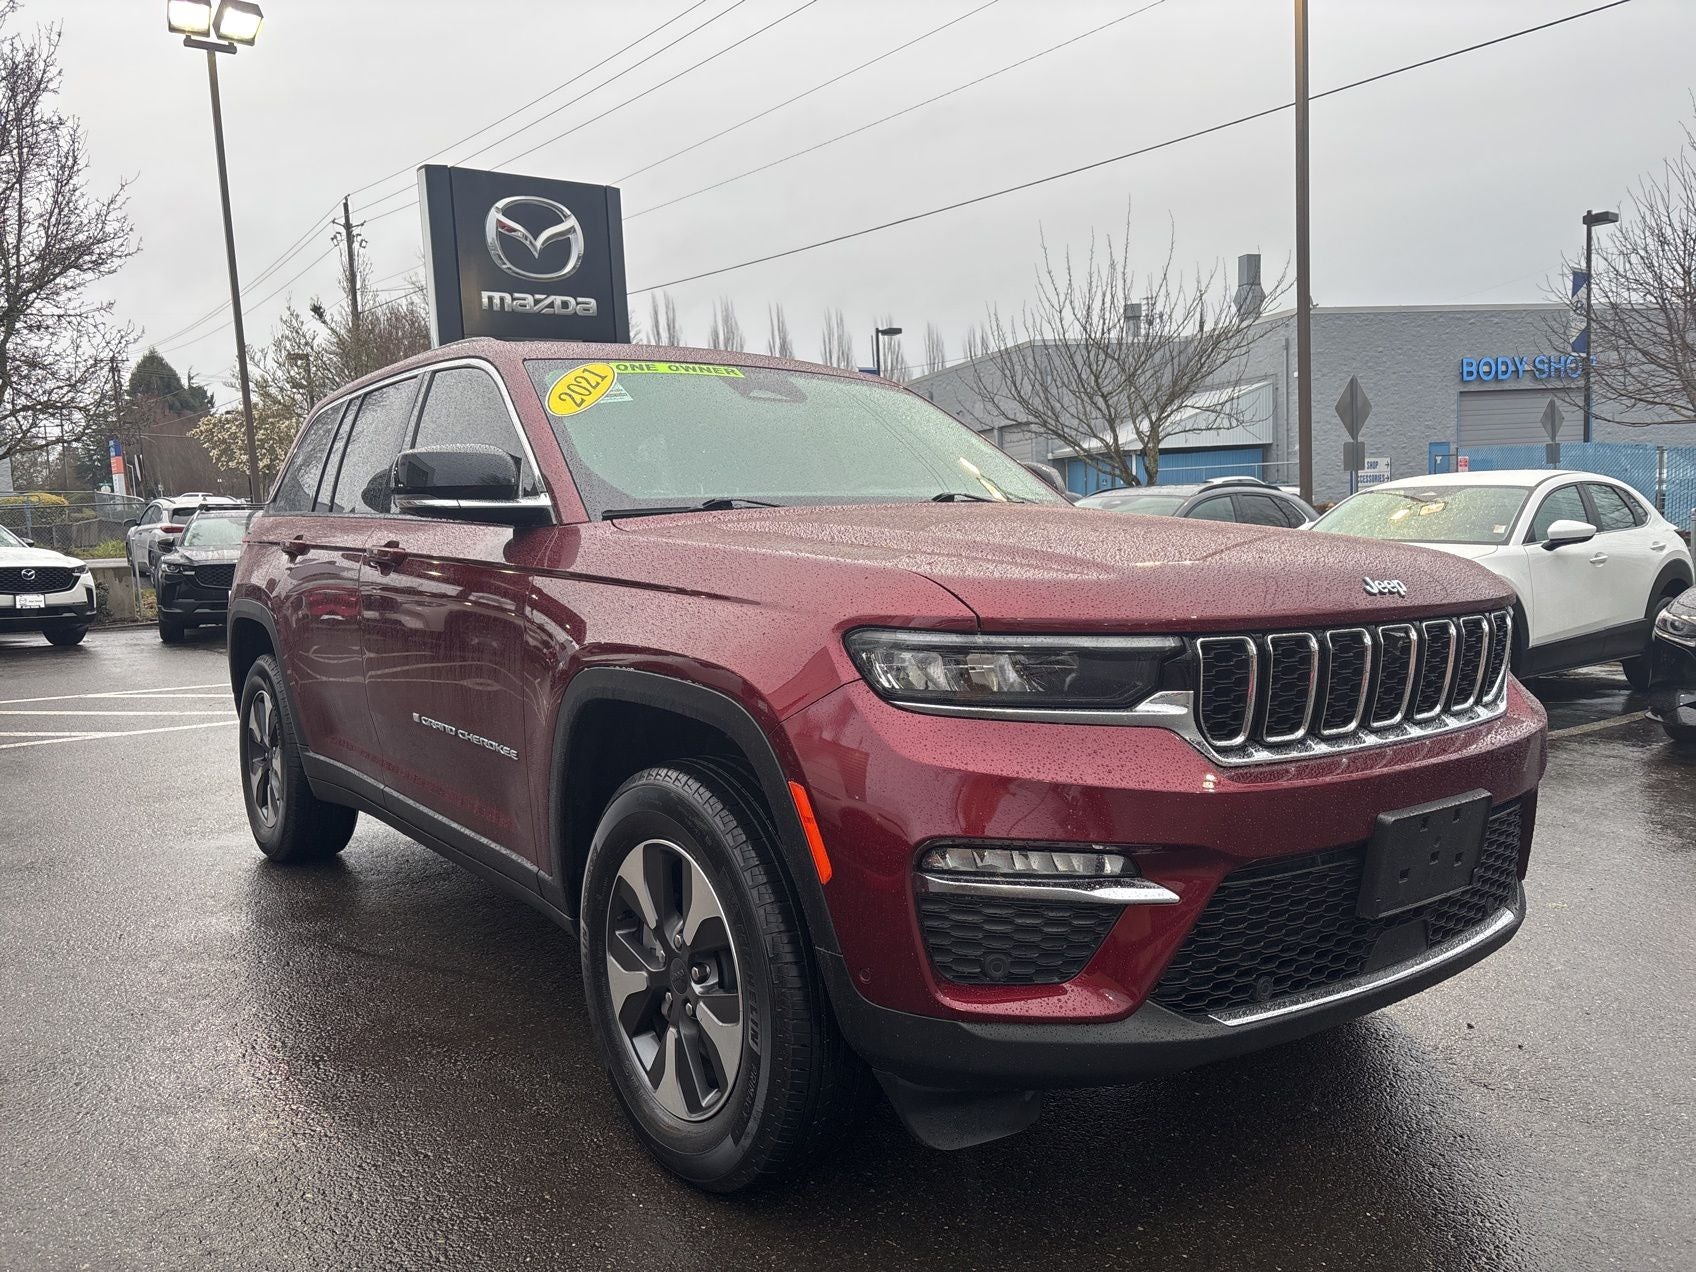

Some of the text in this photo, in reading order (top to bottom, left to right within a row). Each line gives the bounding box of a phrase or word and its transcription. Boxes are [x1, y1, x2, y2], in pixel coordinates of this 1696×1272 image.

[615, 363, 739, 376] ONE OWNER
[1461, 355, 1528, 382] BODY
[558, 367, 608, 409] 2021
[1366, 460, 1379, 470] SHOP
[1362, 577, 1407, 597] Jeep
[421, 716, 519, 761] GRAND CHEROKEE
